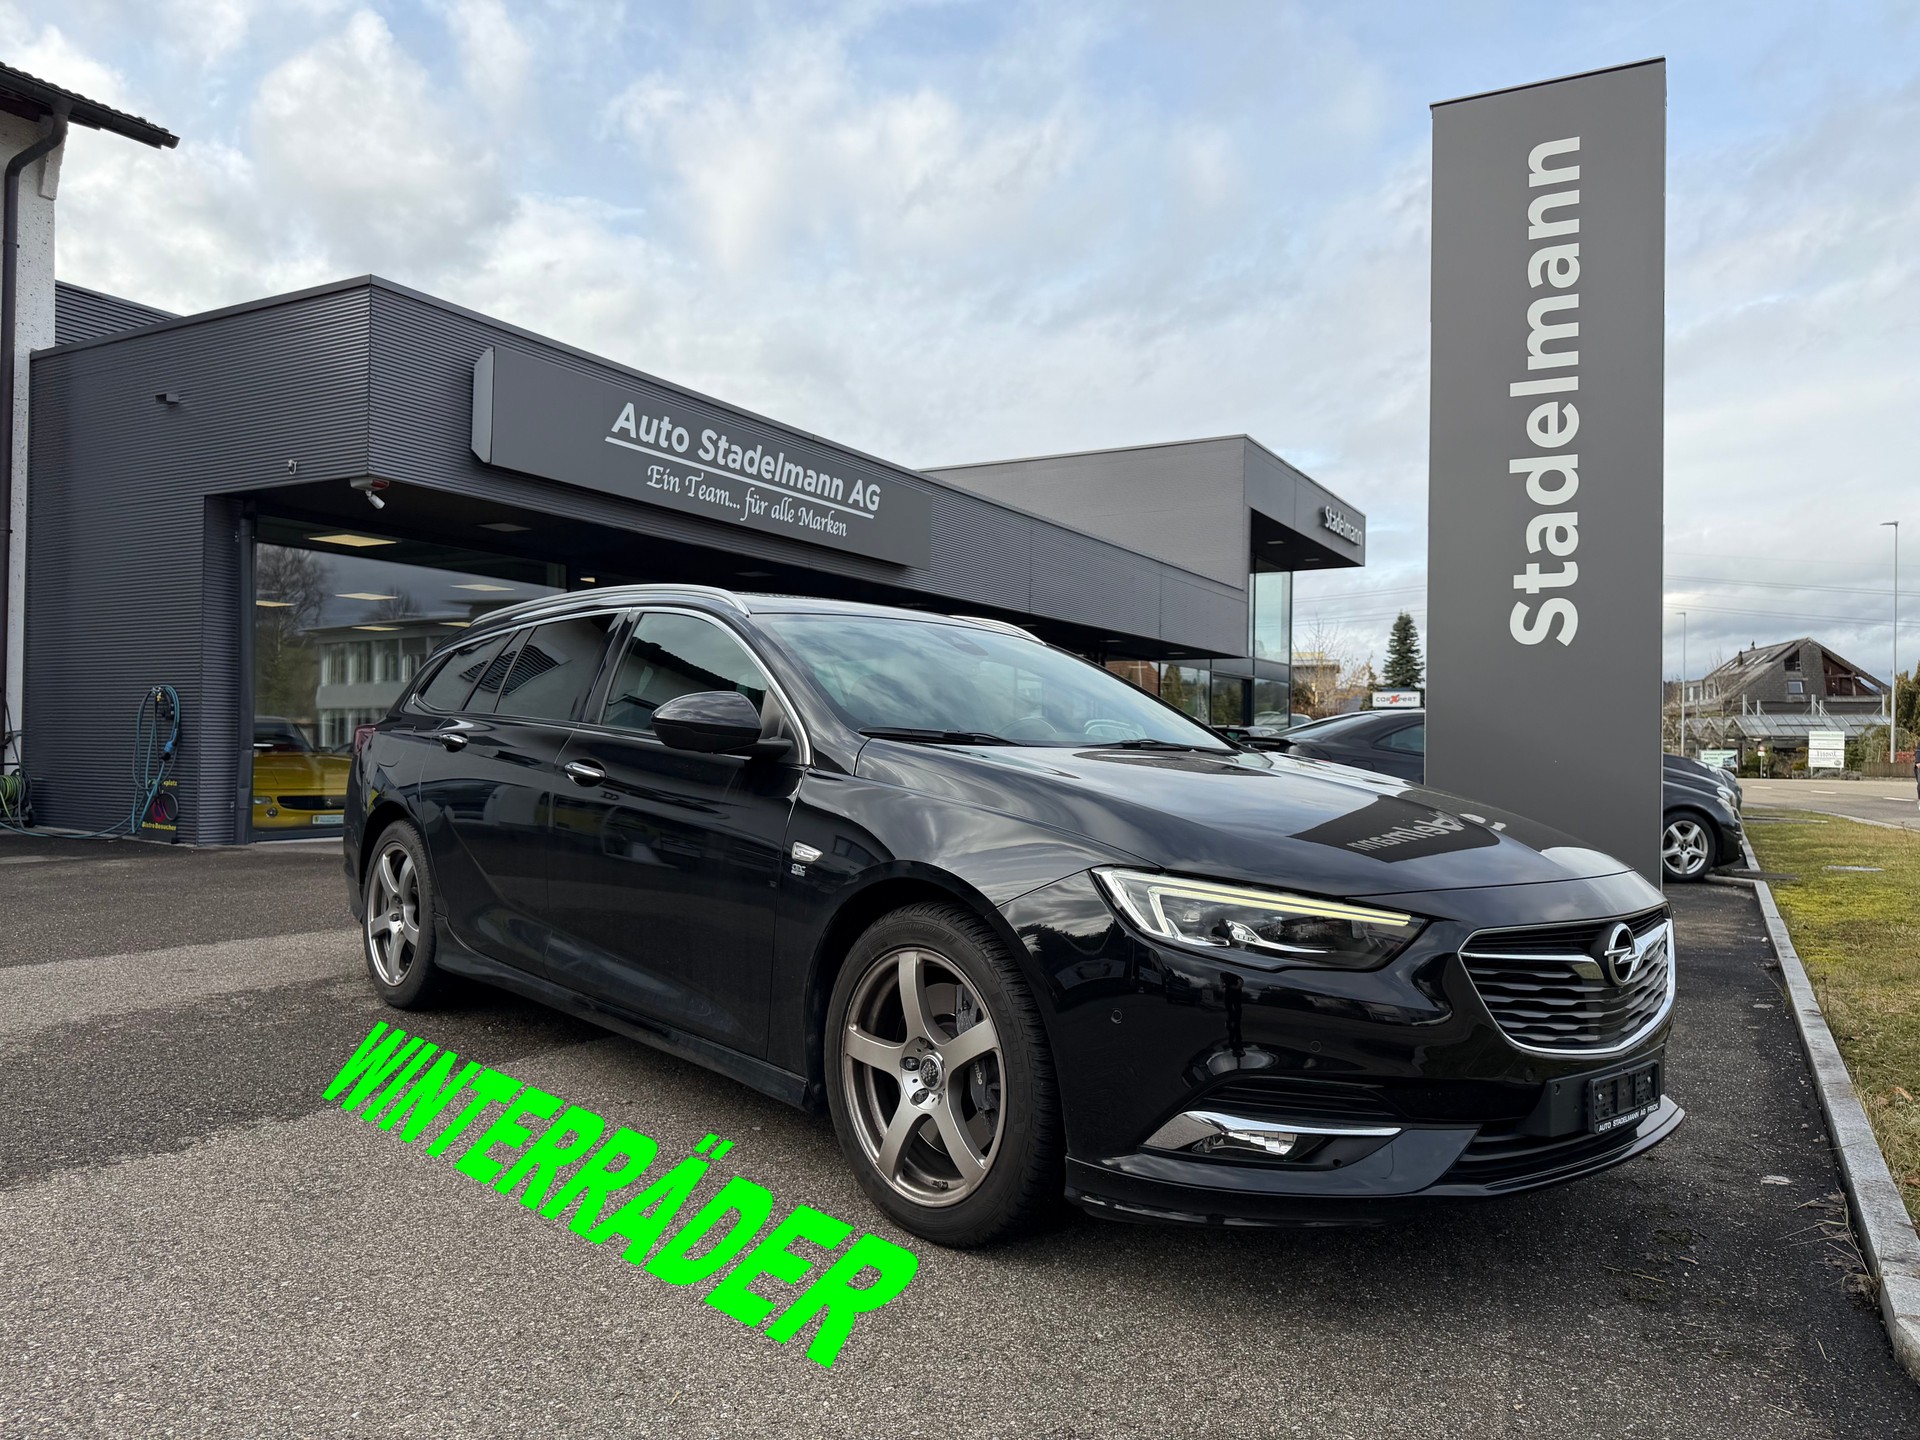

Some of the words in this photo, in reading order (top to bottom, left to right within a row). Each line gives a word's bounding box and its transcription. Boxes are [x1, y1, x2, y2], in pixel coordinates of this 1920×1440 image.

[1509, 136, 1580, 646] Stadelmann
[611, 402, 690, 453] Auto
[698, 428, 844, 500] Stadelmann
[847, 479, 881, 511] AG
[646, 464, 681, 494] Ein
[685, 472, 741, 510] Team...
[740, 486, 769, 521] für
[771, 497, 795, 523] alle
[799, 506, 848, 537] Marken
[1324, 505, 1363, 546] Stadelmann
[1598, 1121, 1611, 1132] AUTO
[1612, 1110, 1640, 1127] STADELMANN
[1647, 1102, 1659, 1113] FRICK
